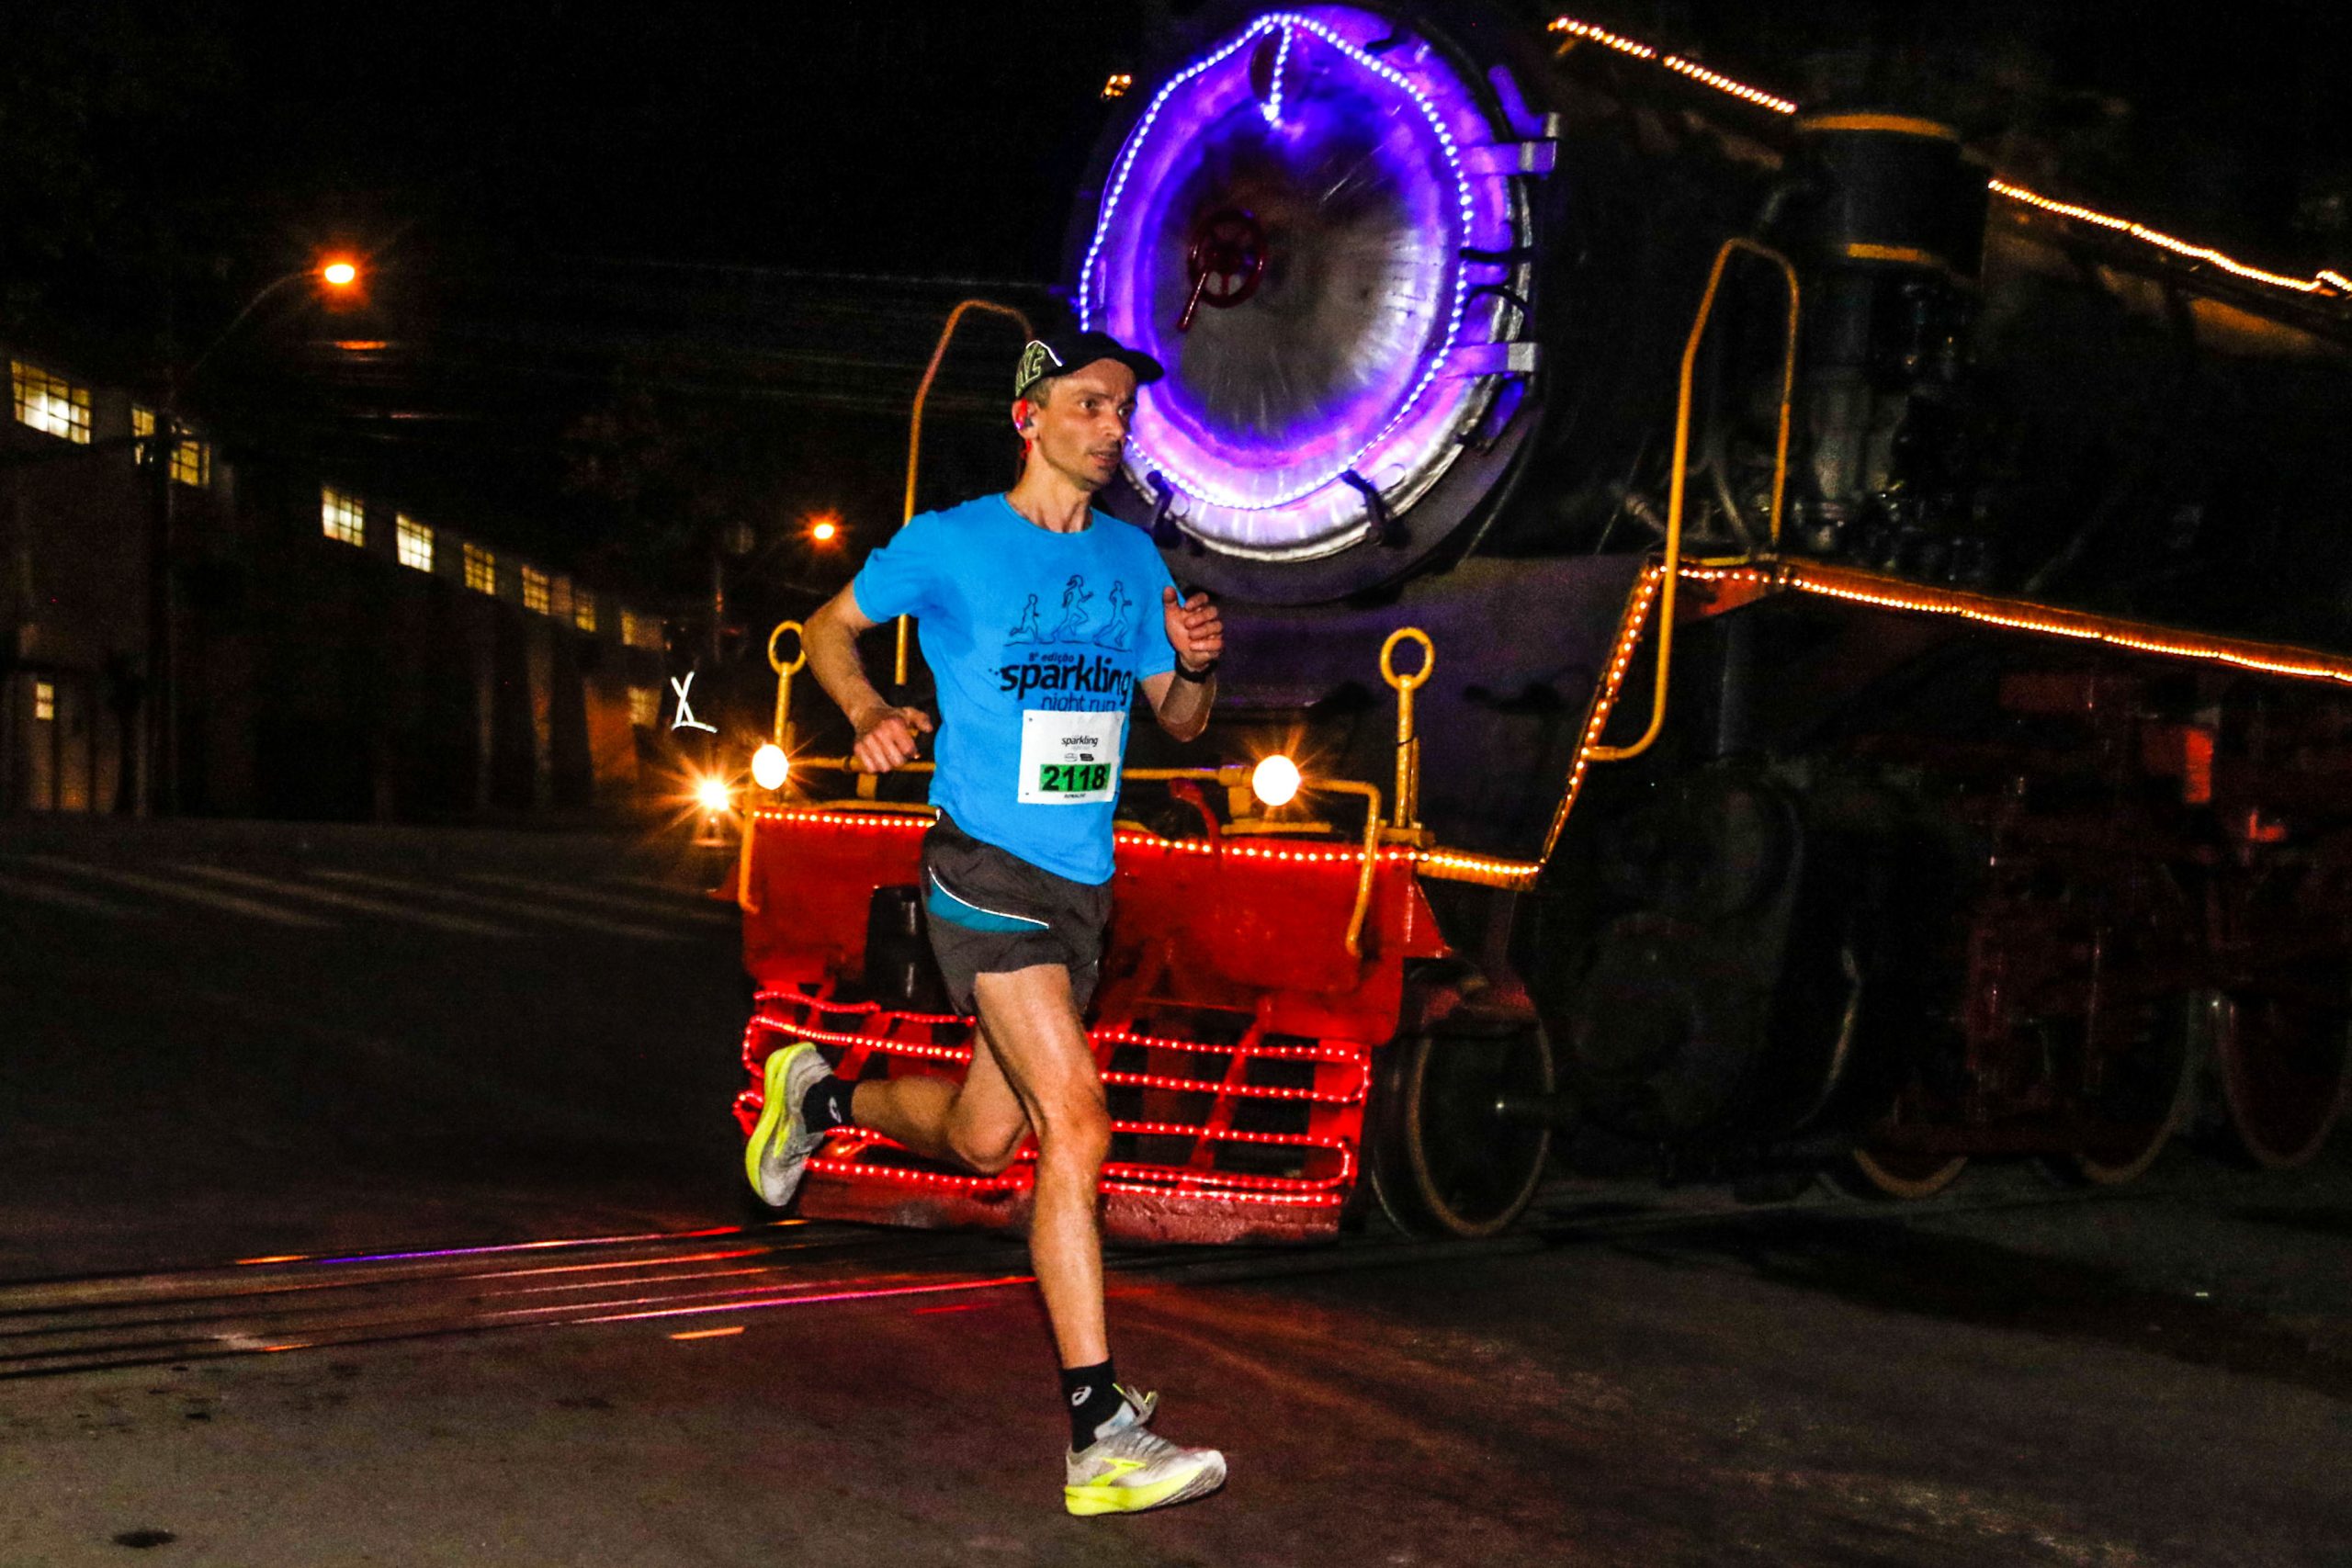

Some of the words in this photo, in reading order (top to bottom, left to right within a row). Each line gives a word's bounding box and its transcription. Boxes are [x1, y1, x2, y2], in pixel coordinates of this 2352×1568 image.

[1000, 653, 1132, 706] sparkling
[1041, 692, 1085, 712] night
[1090, 699, 1117, 712] run
[1061, 735, 1099, 747] sparkling
[1042, 764, 1106, 791] 2118
